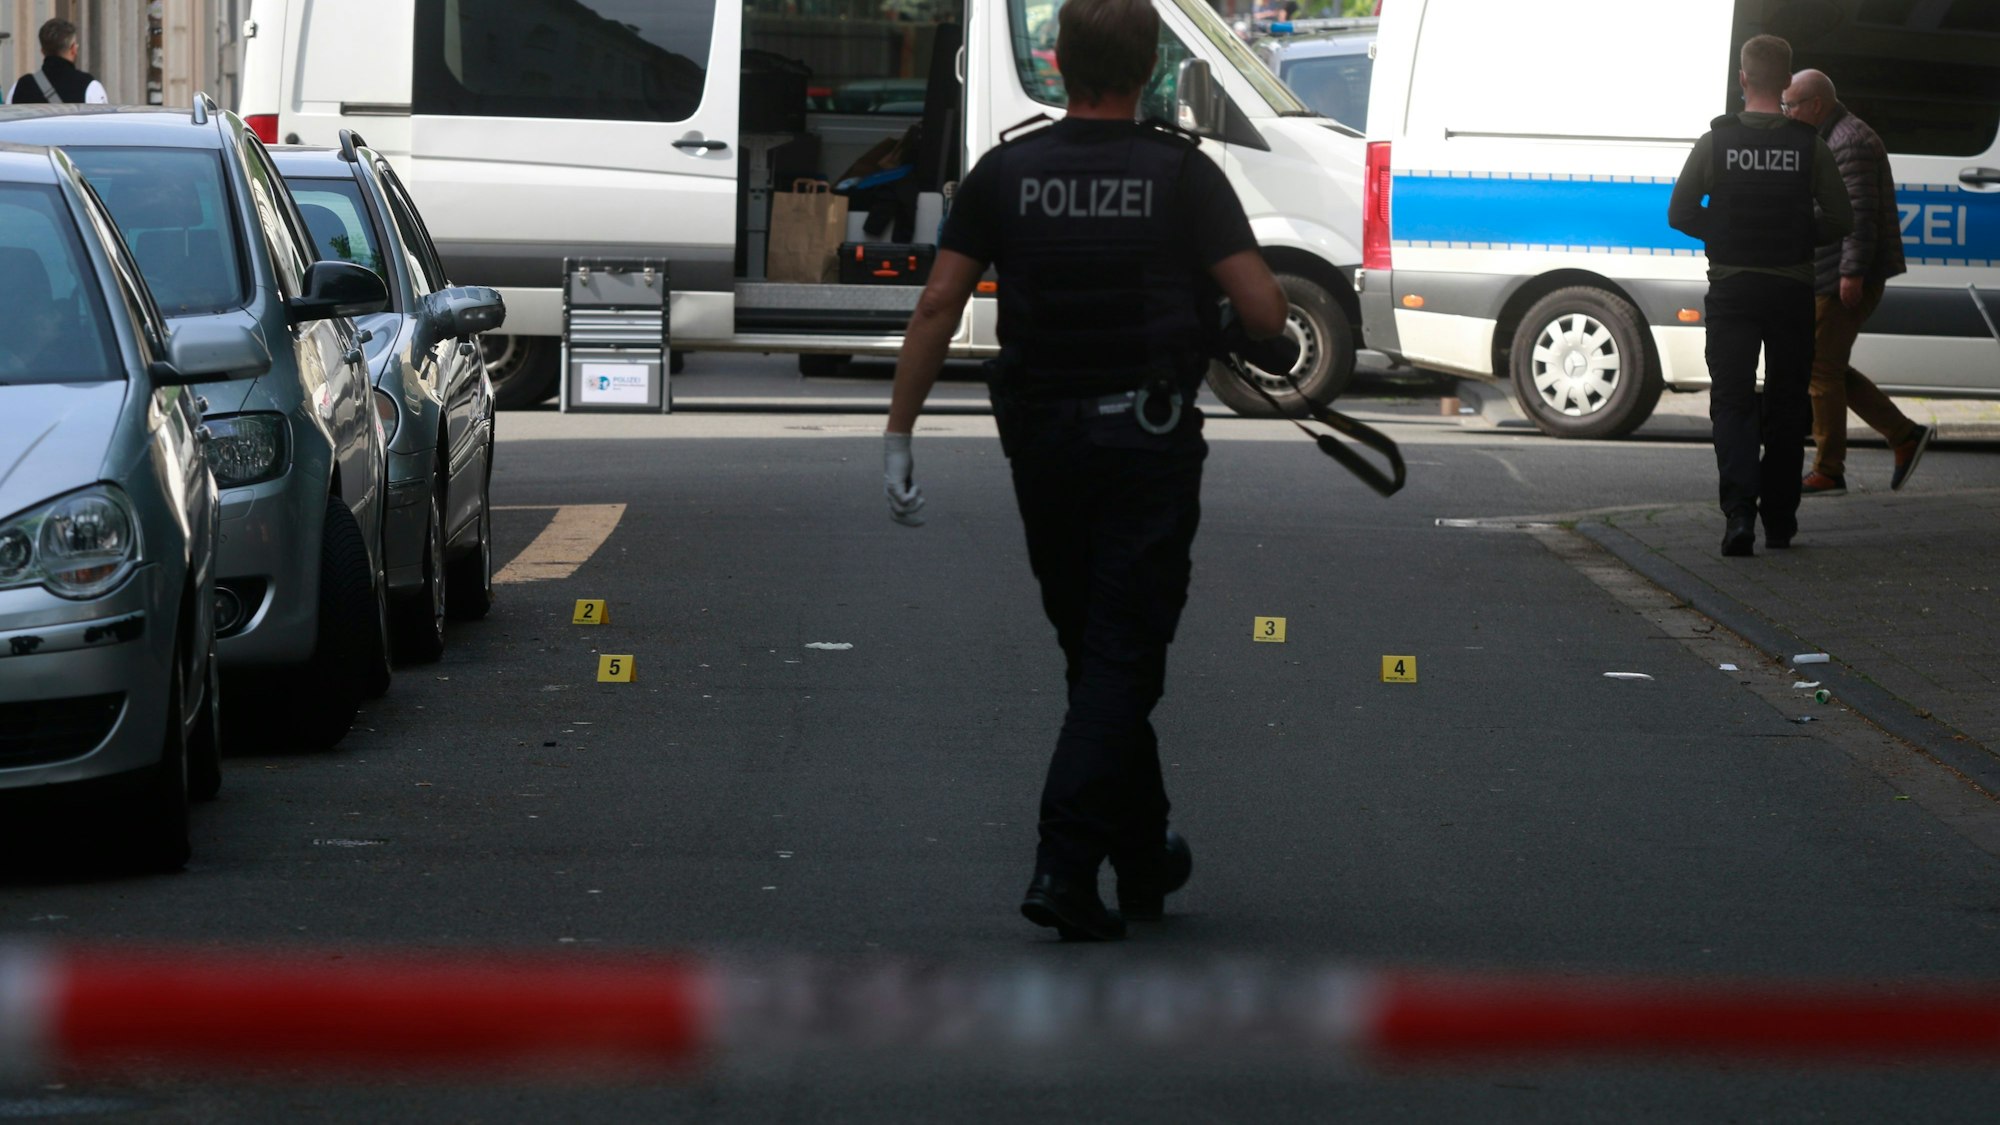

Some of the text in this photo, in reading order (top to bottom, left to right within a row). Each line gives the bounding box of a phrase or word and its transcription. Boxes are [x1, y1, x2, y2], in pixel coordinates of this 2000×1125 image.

[1725, 149, 1799, 171] POLIZEI
[1020, 178, 1153, 217] POLIZEI
[583, 604, 594, 618] 2
[1265, 620, 1275, 636] 3
[609, 659, 620, 675] 5
[1394, 660, 1405, 676] 4
